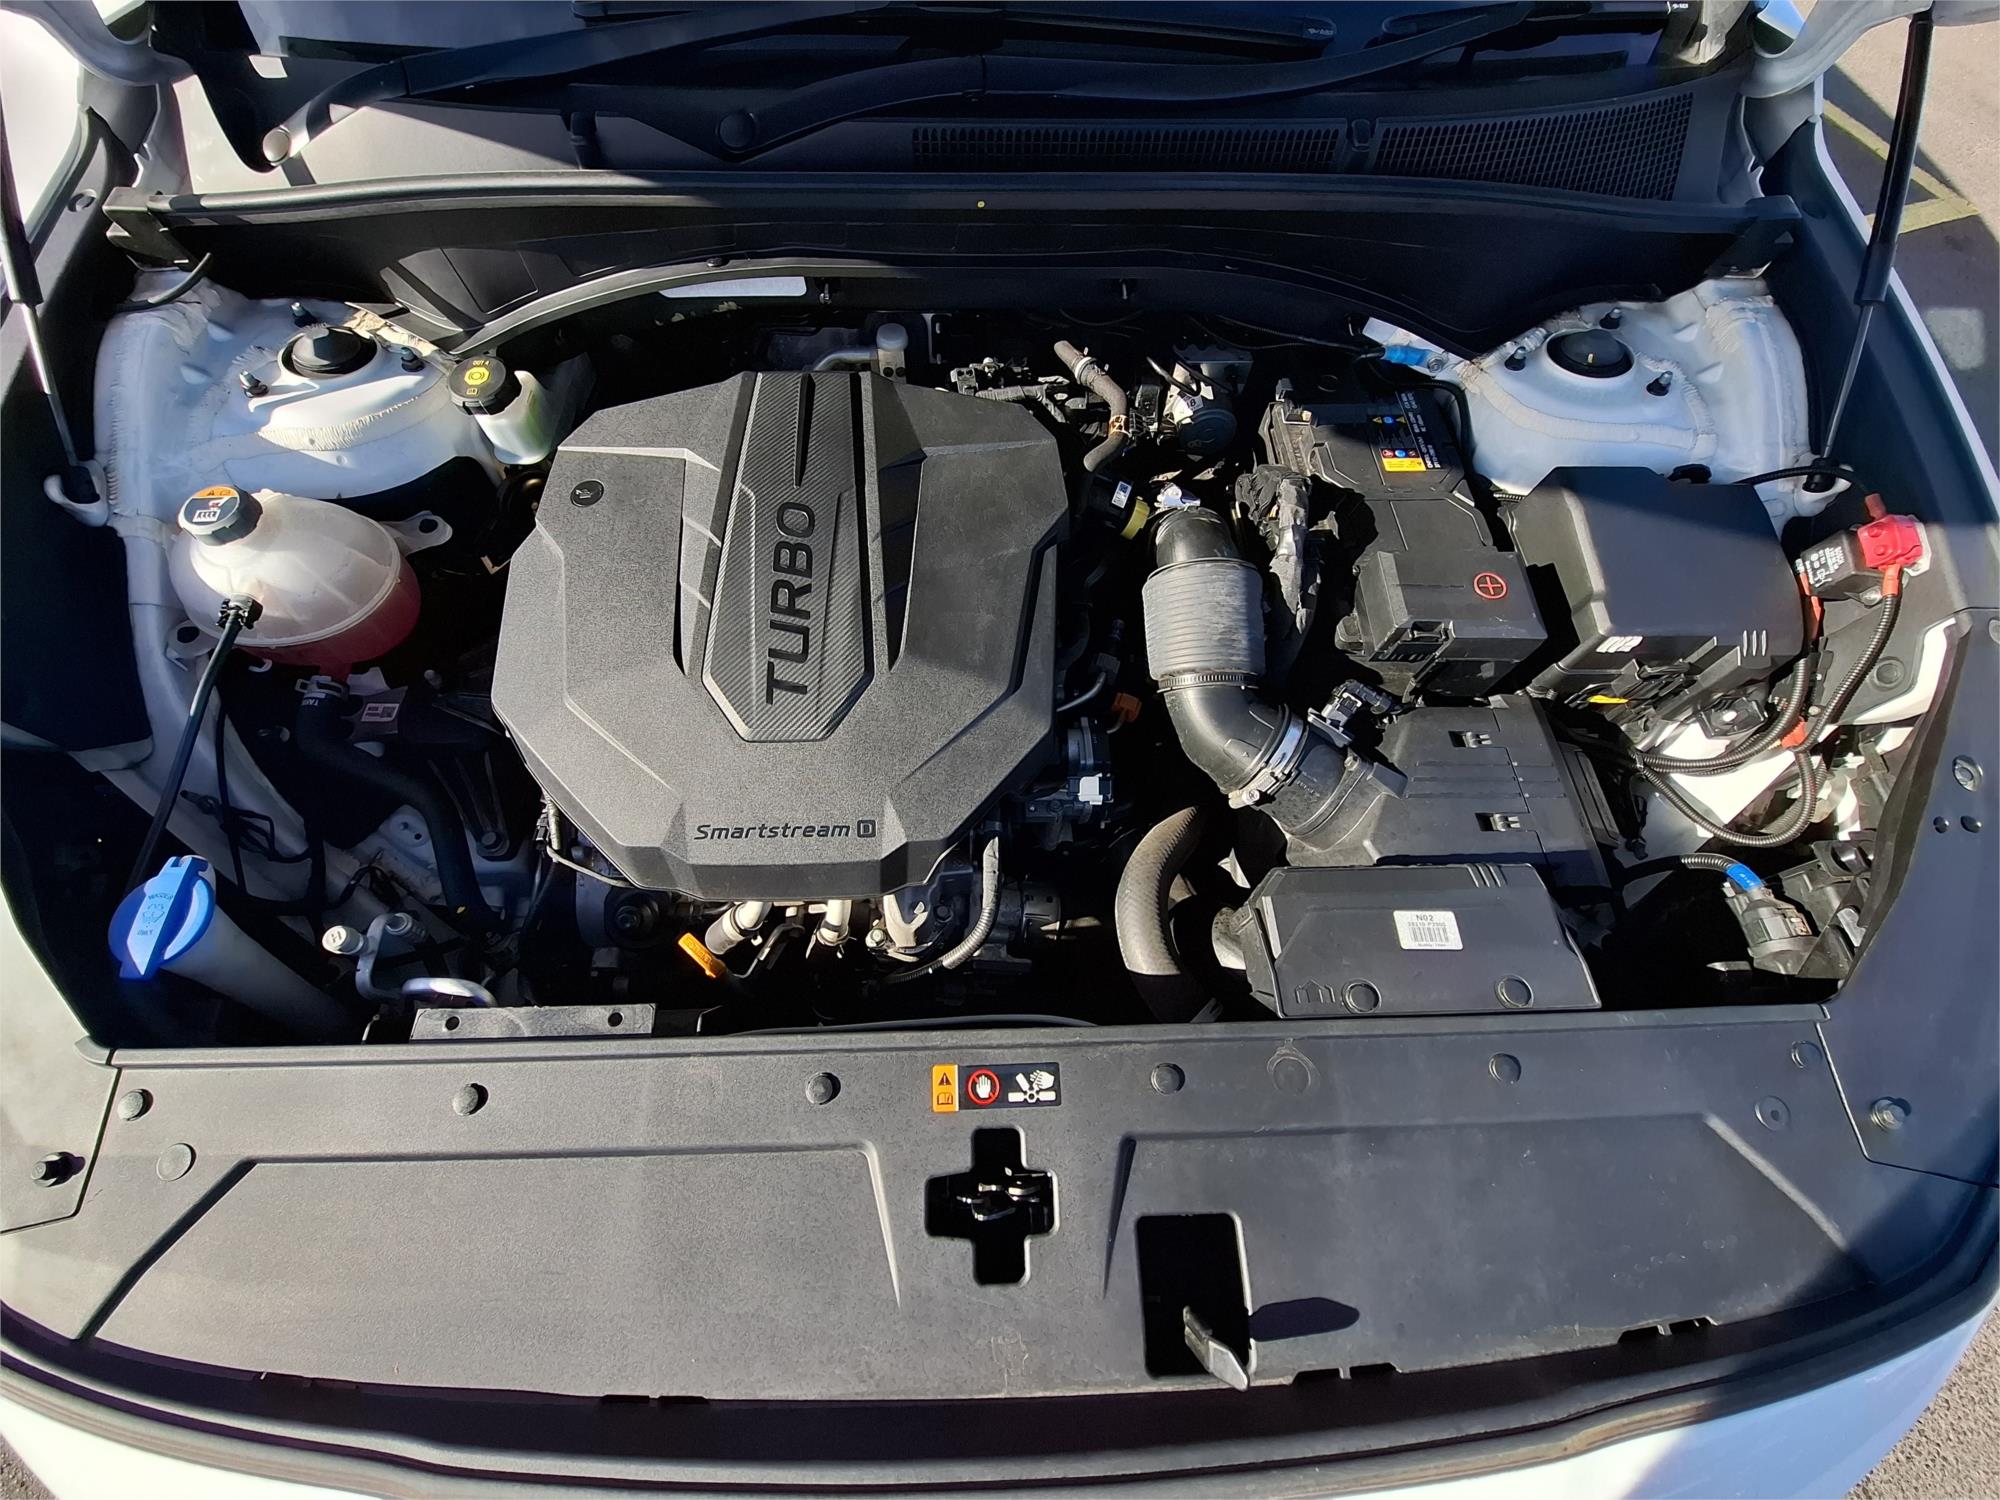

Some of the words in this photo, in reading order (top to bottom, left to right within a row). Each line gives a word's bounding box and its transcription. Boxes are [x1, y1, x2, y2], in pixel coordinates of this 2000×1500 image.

[765, 501, 815, 705] TURBO
[694, 823, 851, 840] Smartstream
[857, 819, 877, 838] D
